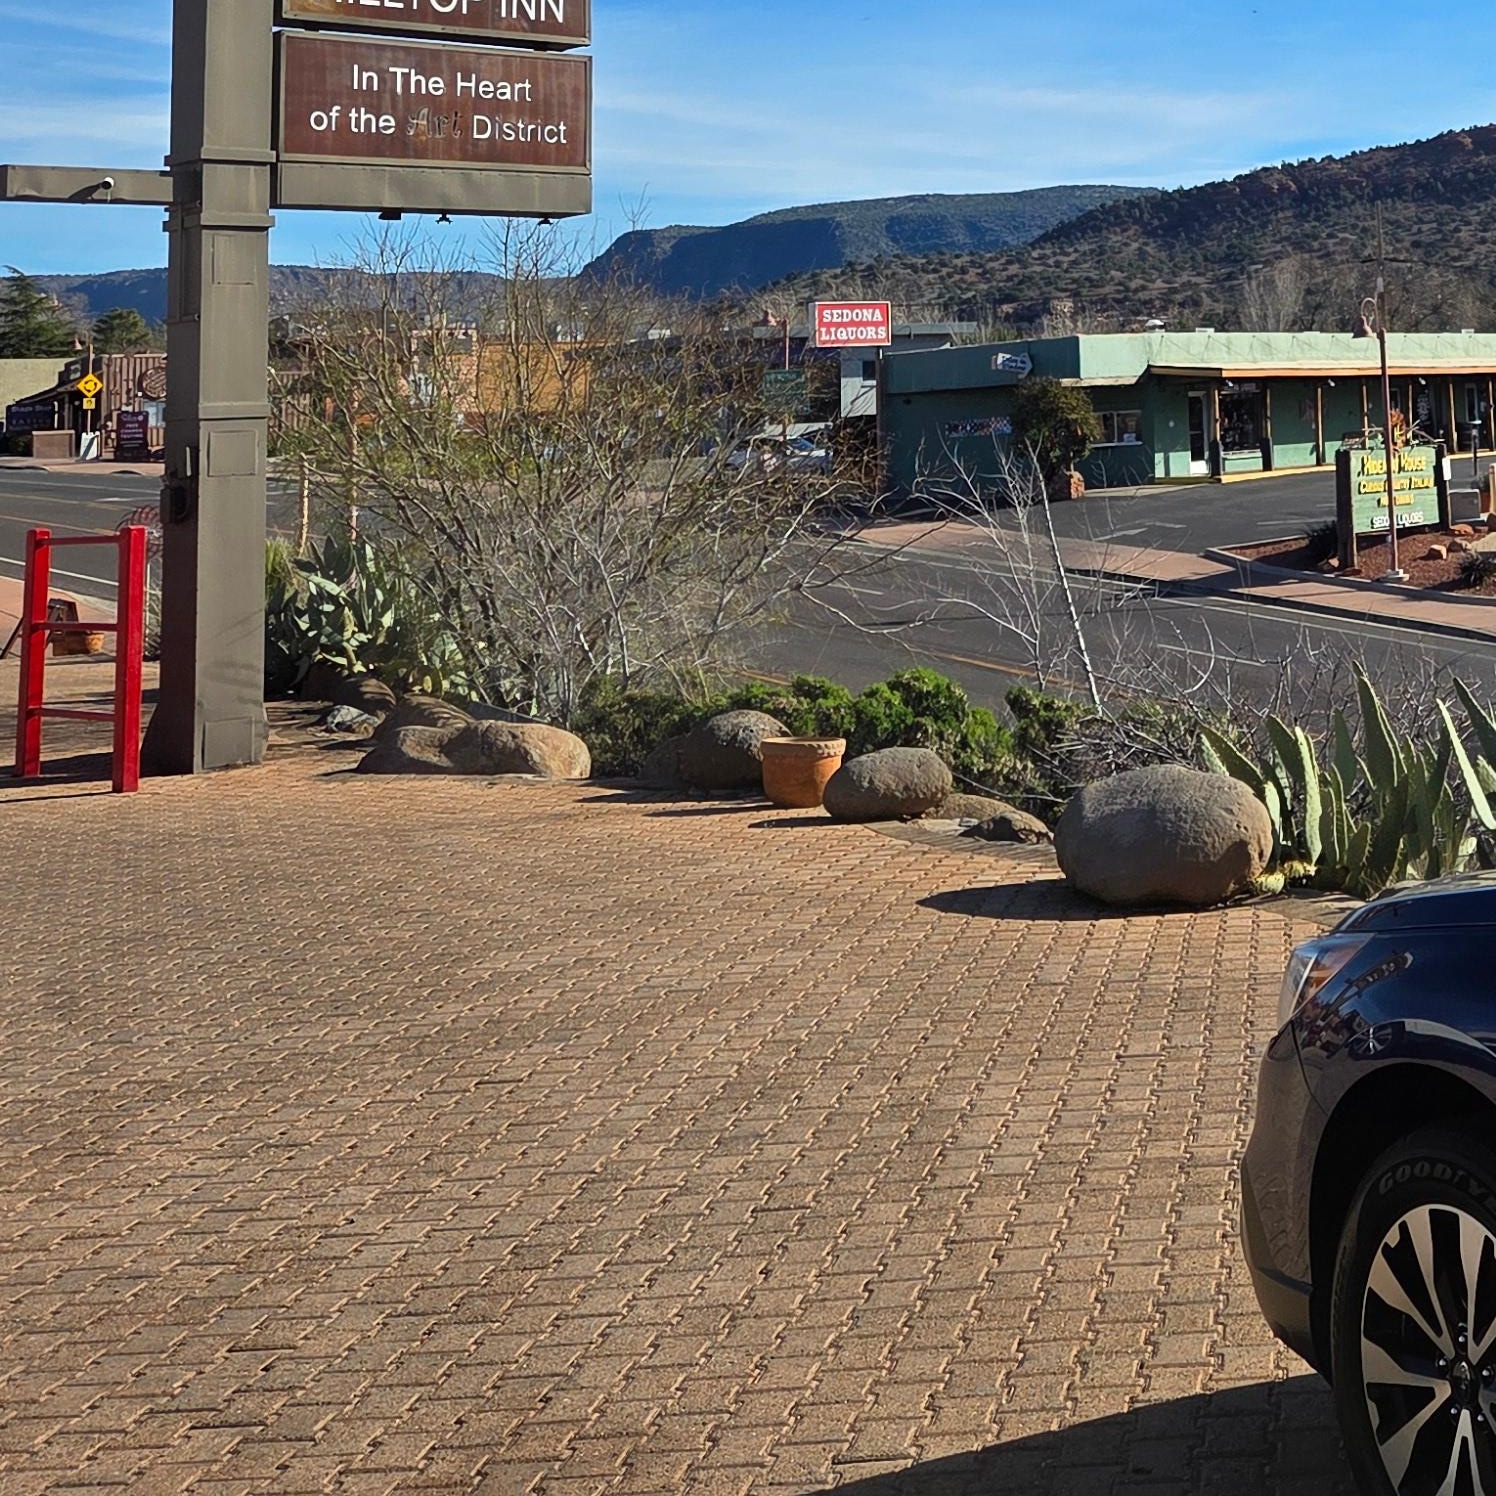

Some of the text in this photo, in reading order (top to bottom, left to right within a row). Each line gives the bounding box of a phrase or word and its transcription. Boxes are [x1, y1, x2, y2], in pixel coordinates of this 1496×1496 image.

[352, 64, 532, 102] In The Heart
[309, 105, 568, 145] of the Art District
[823, 309, 883, 322] SEDONA
[820, 326, 886, 340] LIQUORS
